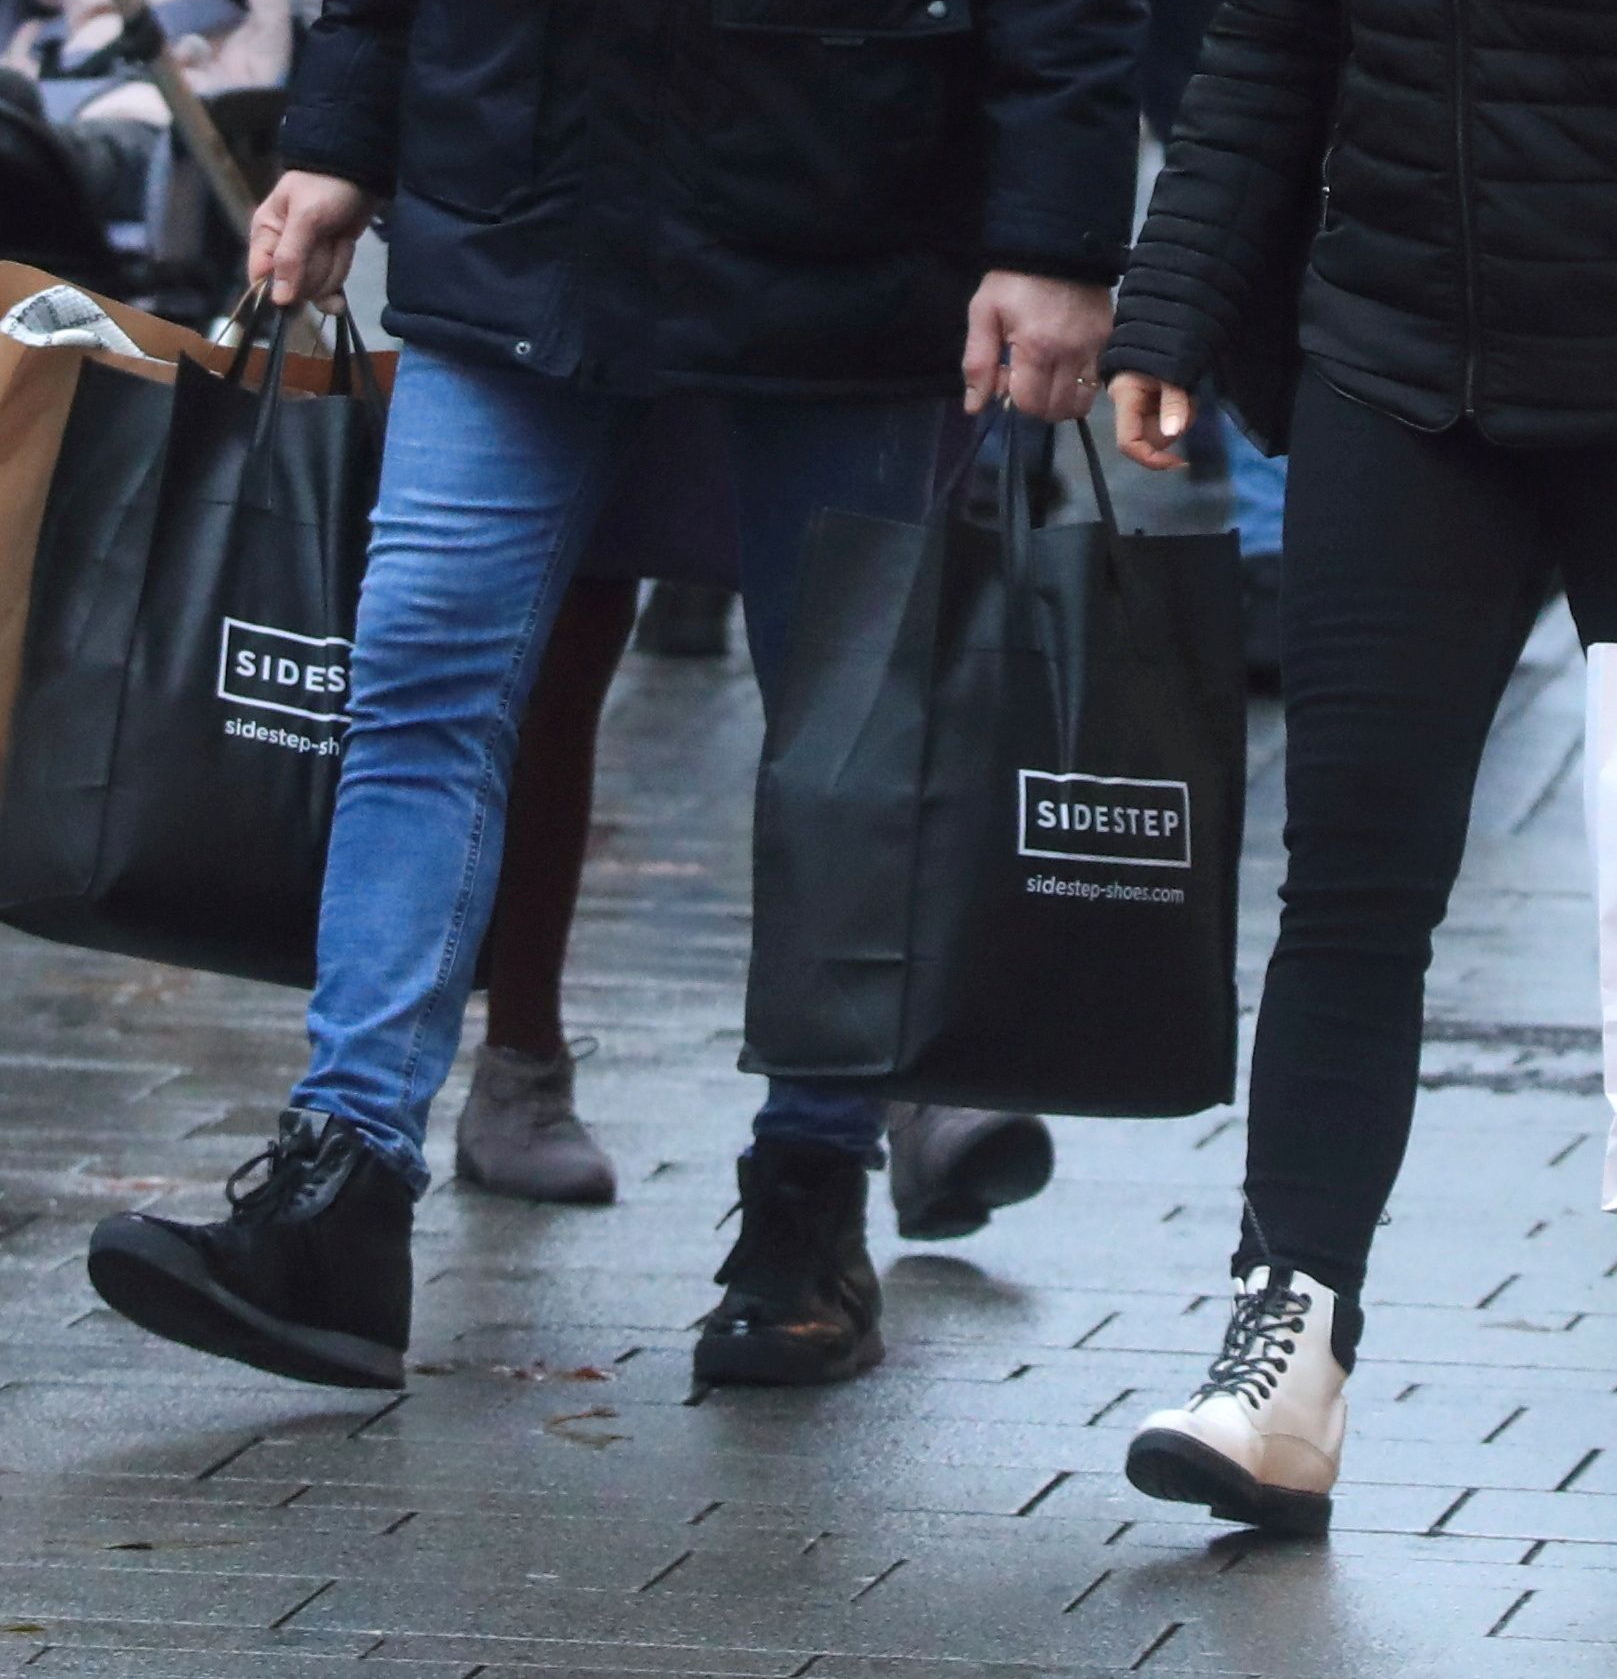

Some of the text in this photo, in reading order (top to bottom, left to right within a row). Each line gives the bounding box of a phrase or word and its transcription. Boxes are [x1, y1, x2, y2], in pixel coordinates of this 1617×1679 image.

[236, 650, 346, 693] SIDES
[224, 718, 340, 756] sidestep-sh
[1037, 800, 1179, 837] SIDESTEP
[1026, 874, 1184, 904] sidestep-shoes.com
